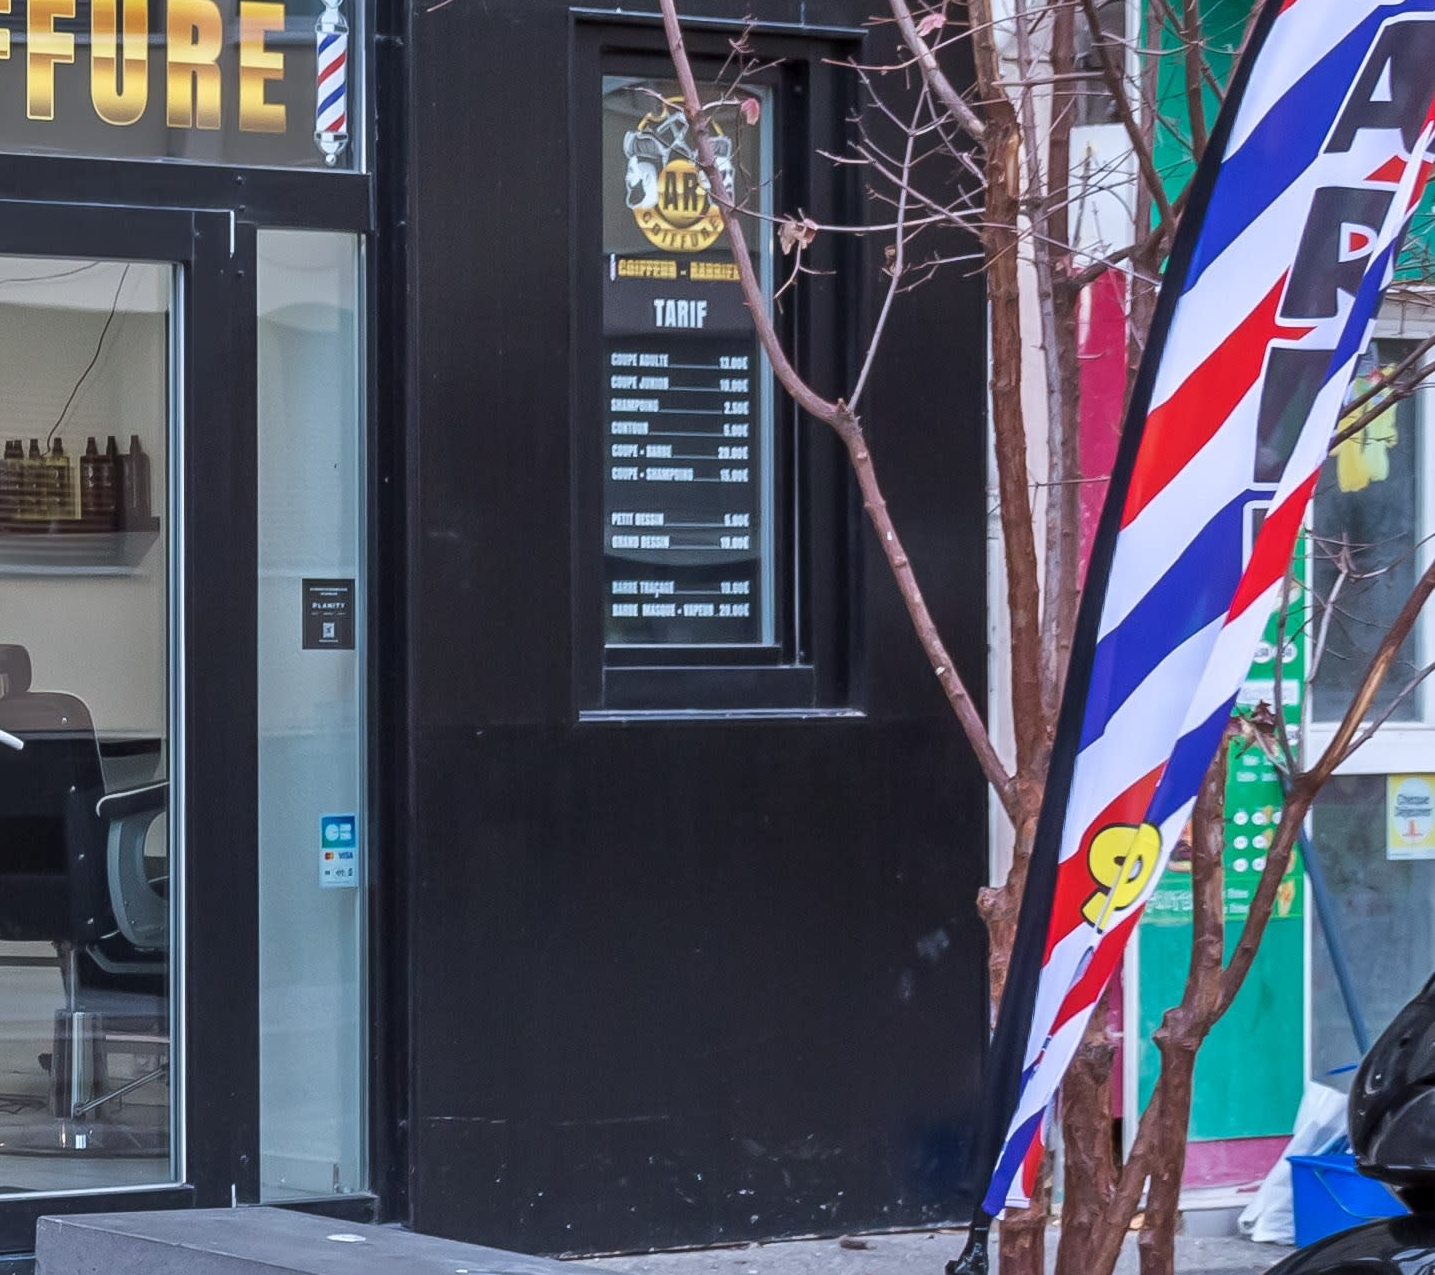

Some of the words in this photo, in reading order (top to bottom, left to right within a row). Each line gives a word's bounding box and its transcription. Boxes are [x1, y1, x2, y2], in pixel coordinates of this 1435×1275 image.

[663, 171, 698, 212] AR
[653, 299, 708, 329] TARIF
[338, 851, 354, 860] VISA
